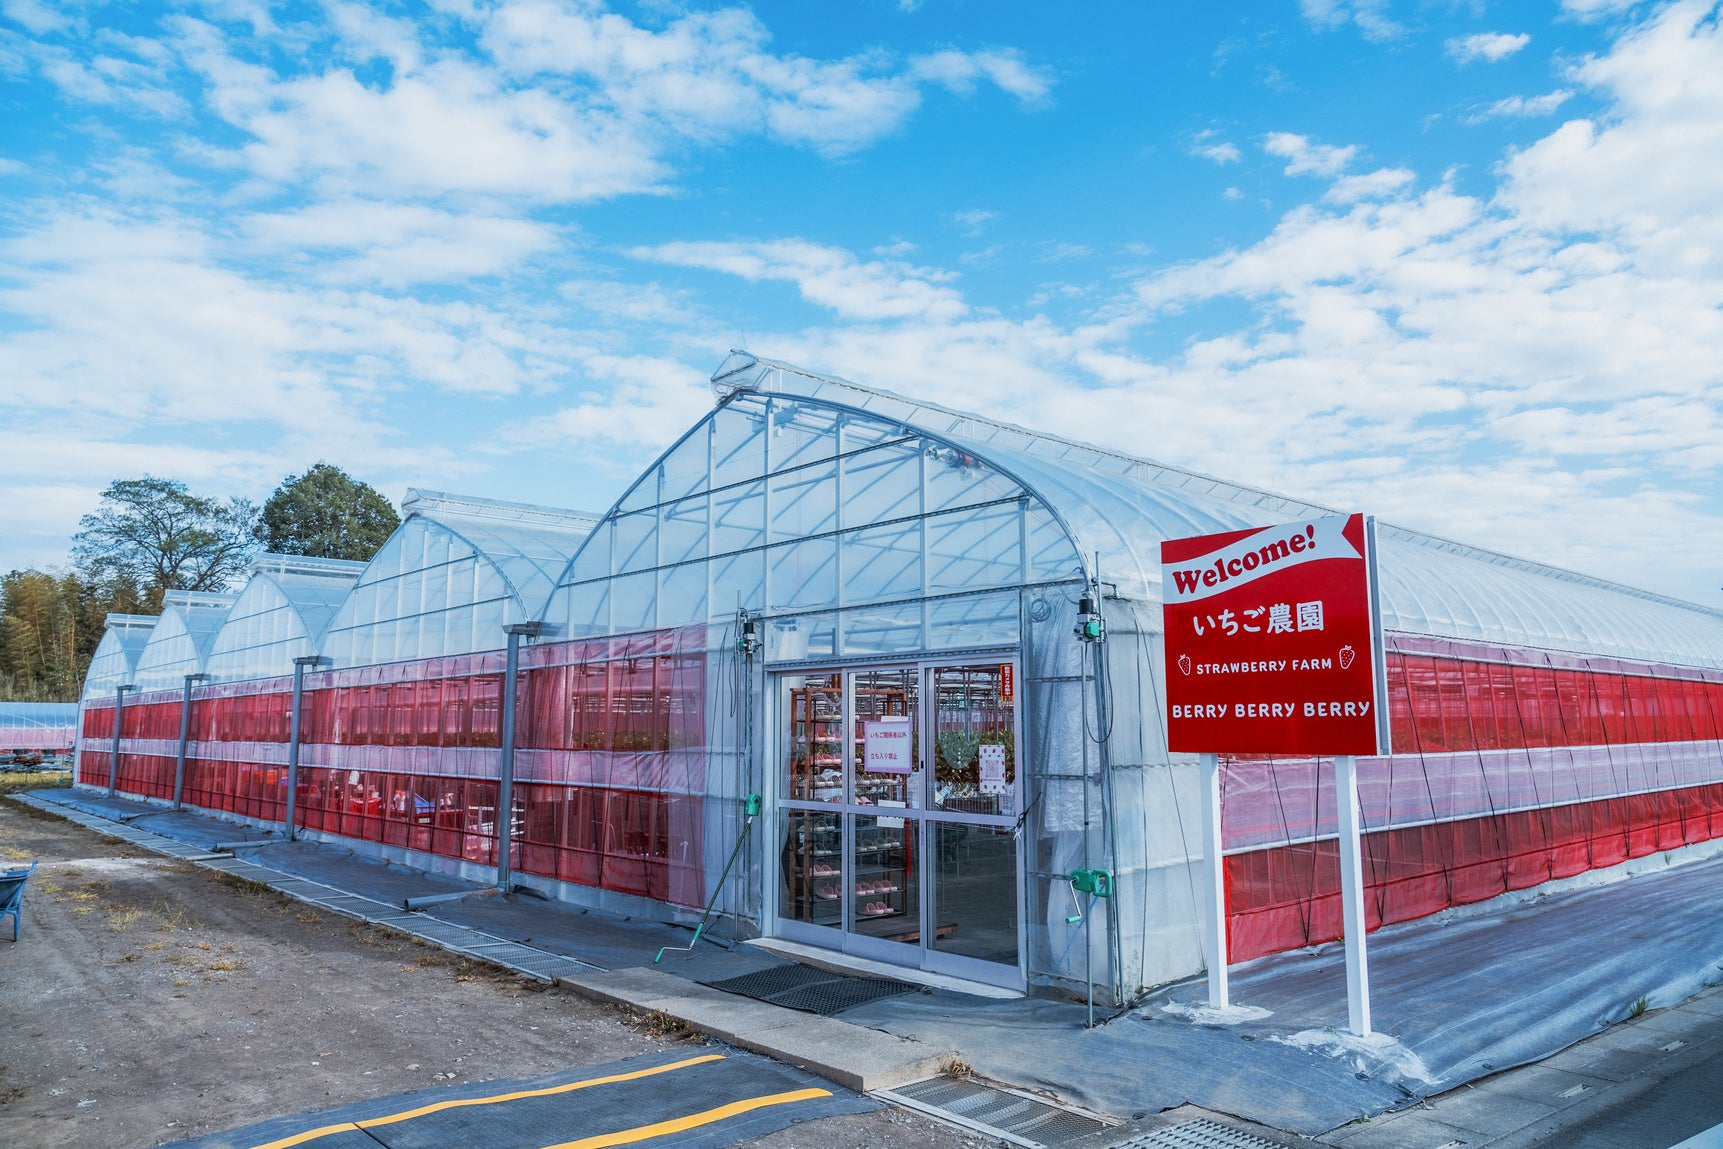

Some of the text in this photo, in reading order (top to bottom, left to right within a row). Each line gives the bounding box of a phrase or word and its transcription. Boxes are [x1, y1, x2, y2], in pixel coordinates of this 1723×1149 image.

[1172, 524, 1316, 595] Welcome!
[1193, 600, 1325, 636] いちご農園
[1196, 658, 1332, 675] STRAWBERRY FARM
[1172, 701, 1370, 718] BERRY BERRY BERRY
